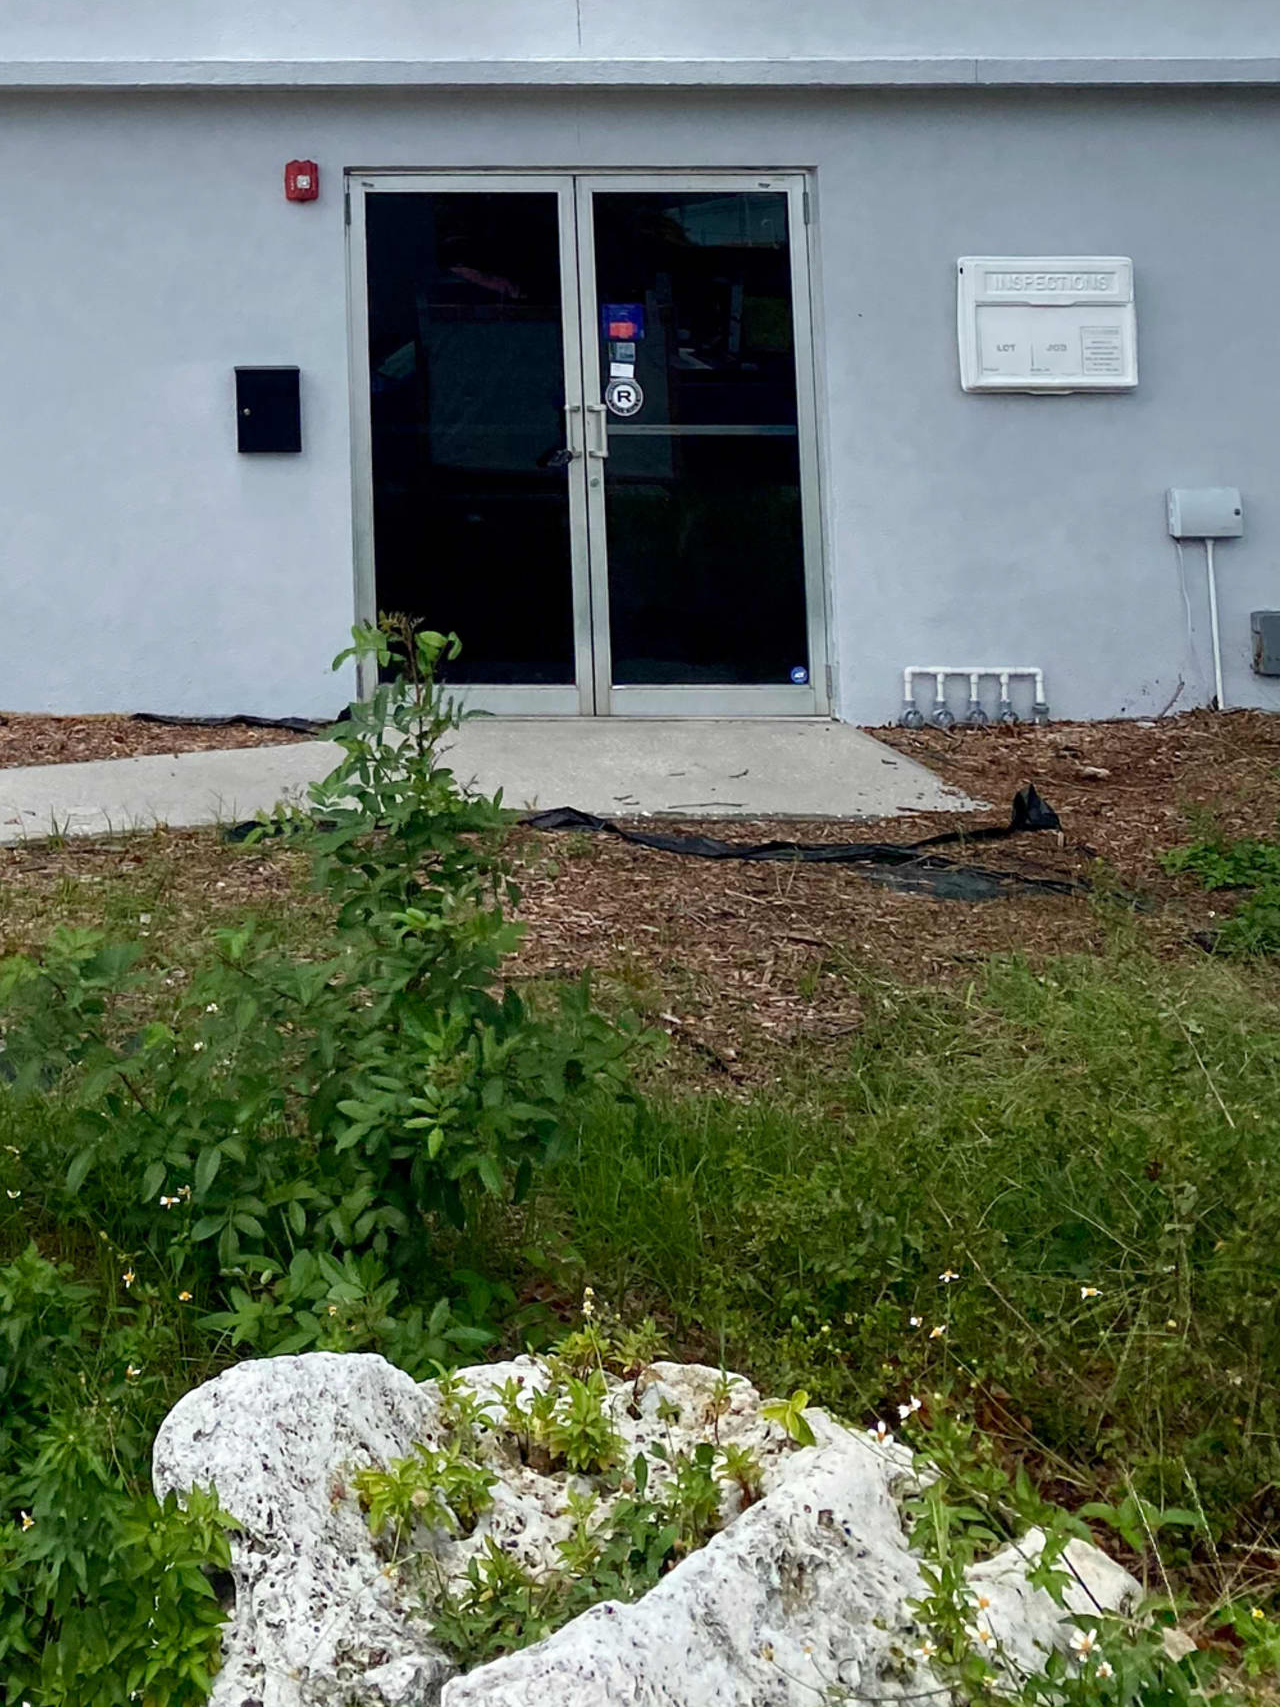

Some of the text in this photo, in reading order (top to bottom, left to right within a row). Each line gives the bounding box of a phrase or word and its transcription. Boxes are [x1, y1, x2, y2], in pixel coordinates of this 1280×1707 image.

[994, 274, 1109, 292] INSPECTIONS
[996, 344, 1016, 353] LOT
[617, 390, 632, 403] R
